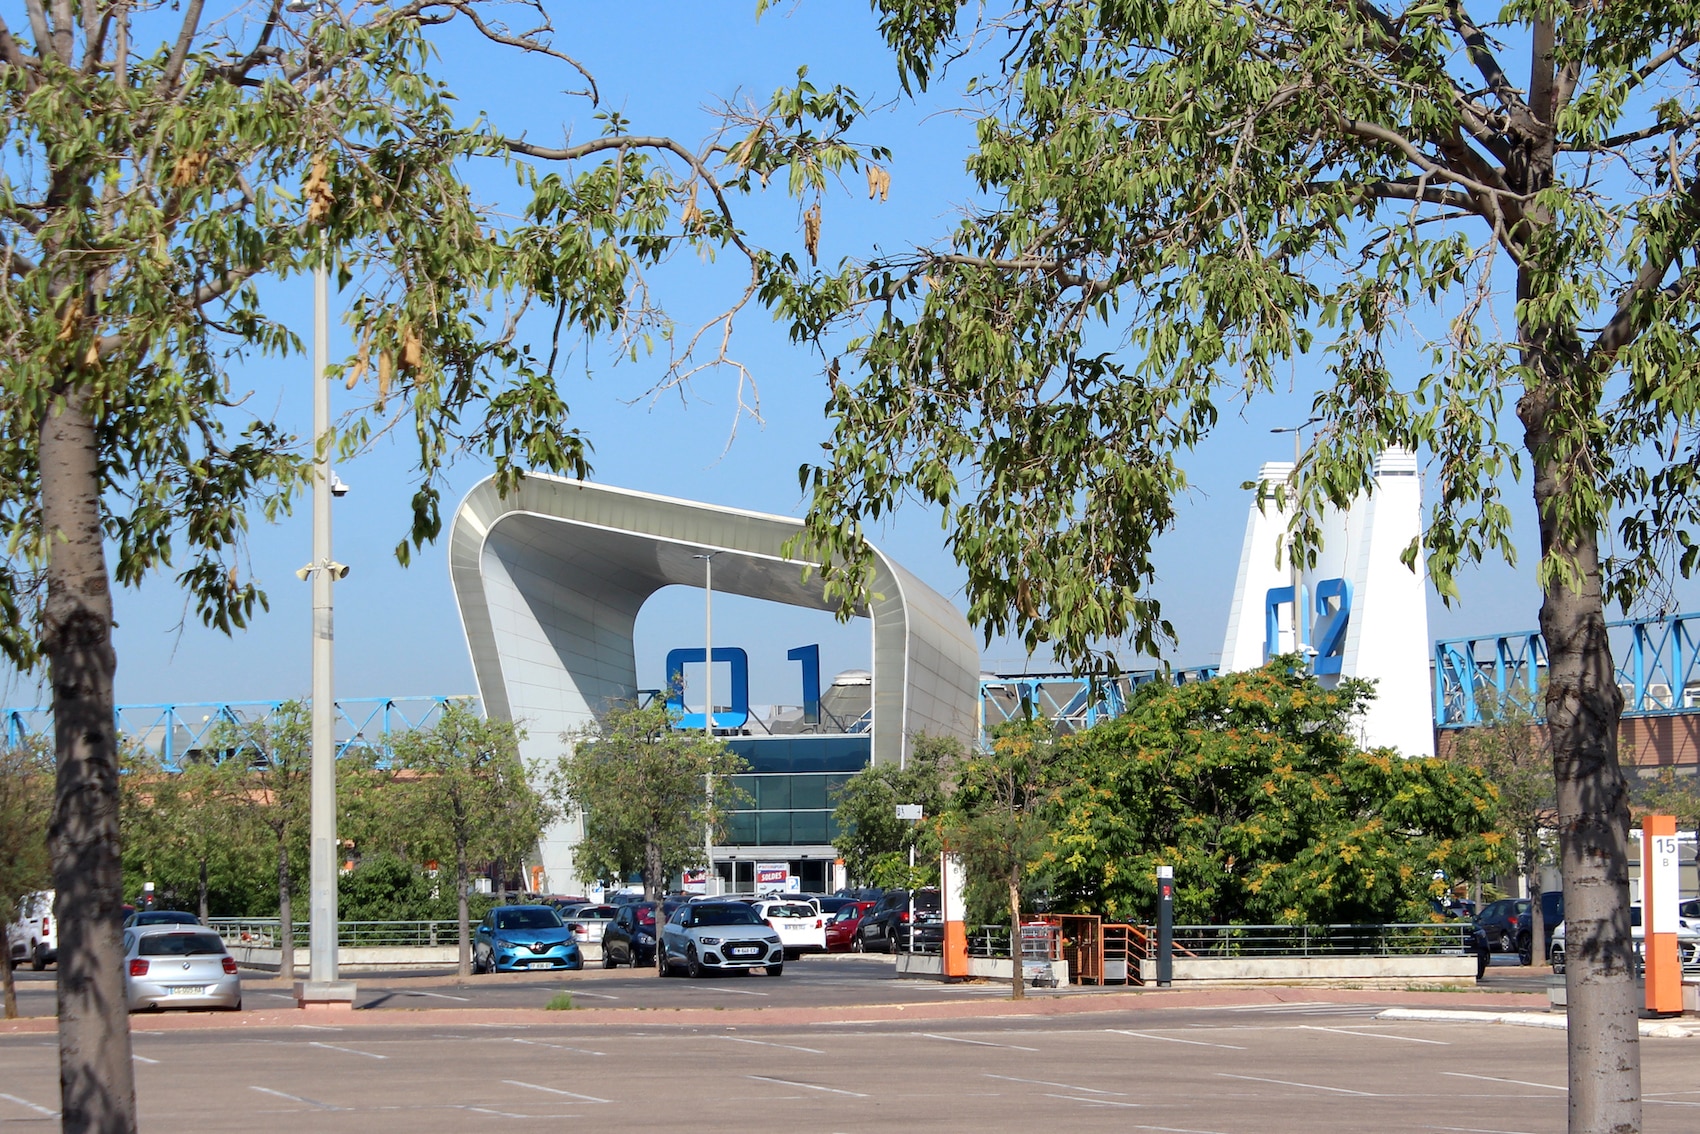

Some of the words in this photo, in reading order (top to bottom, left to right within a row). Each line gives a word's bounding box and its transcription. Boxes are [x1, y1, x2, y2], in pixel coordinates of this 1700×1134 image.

[666, 644, 821, 729] 01
[1656, 838, 1676, 854] 15
[1662, 858, 1669, 867] B
[761, 871, 783, 881] SOLDES
